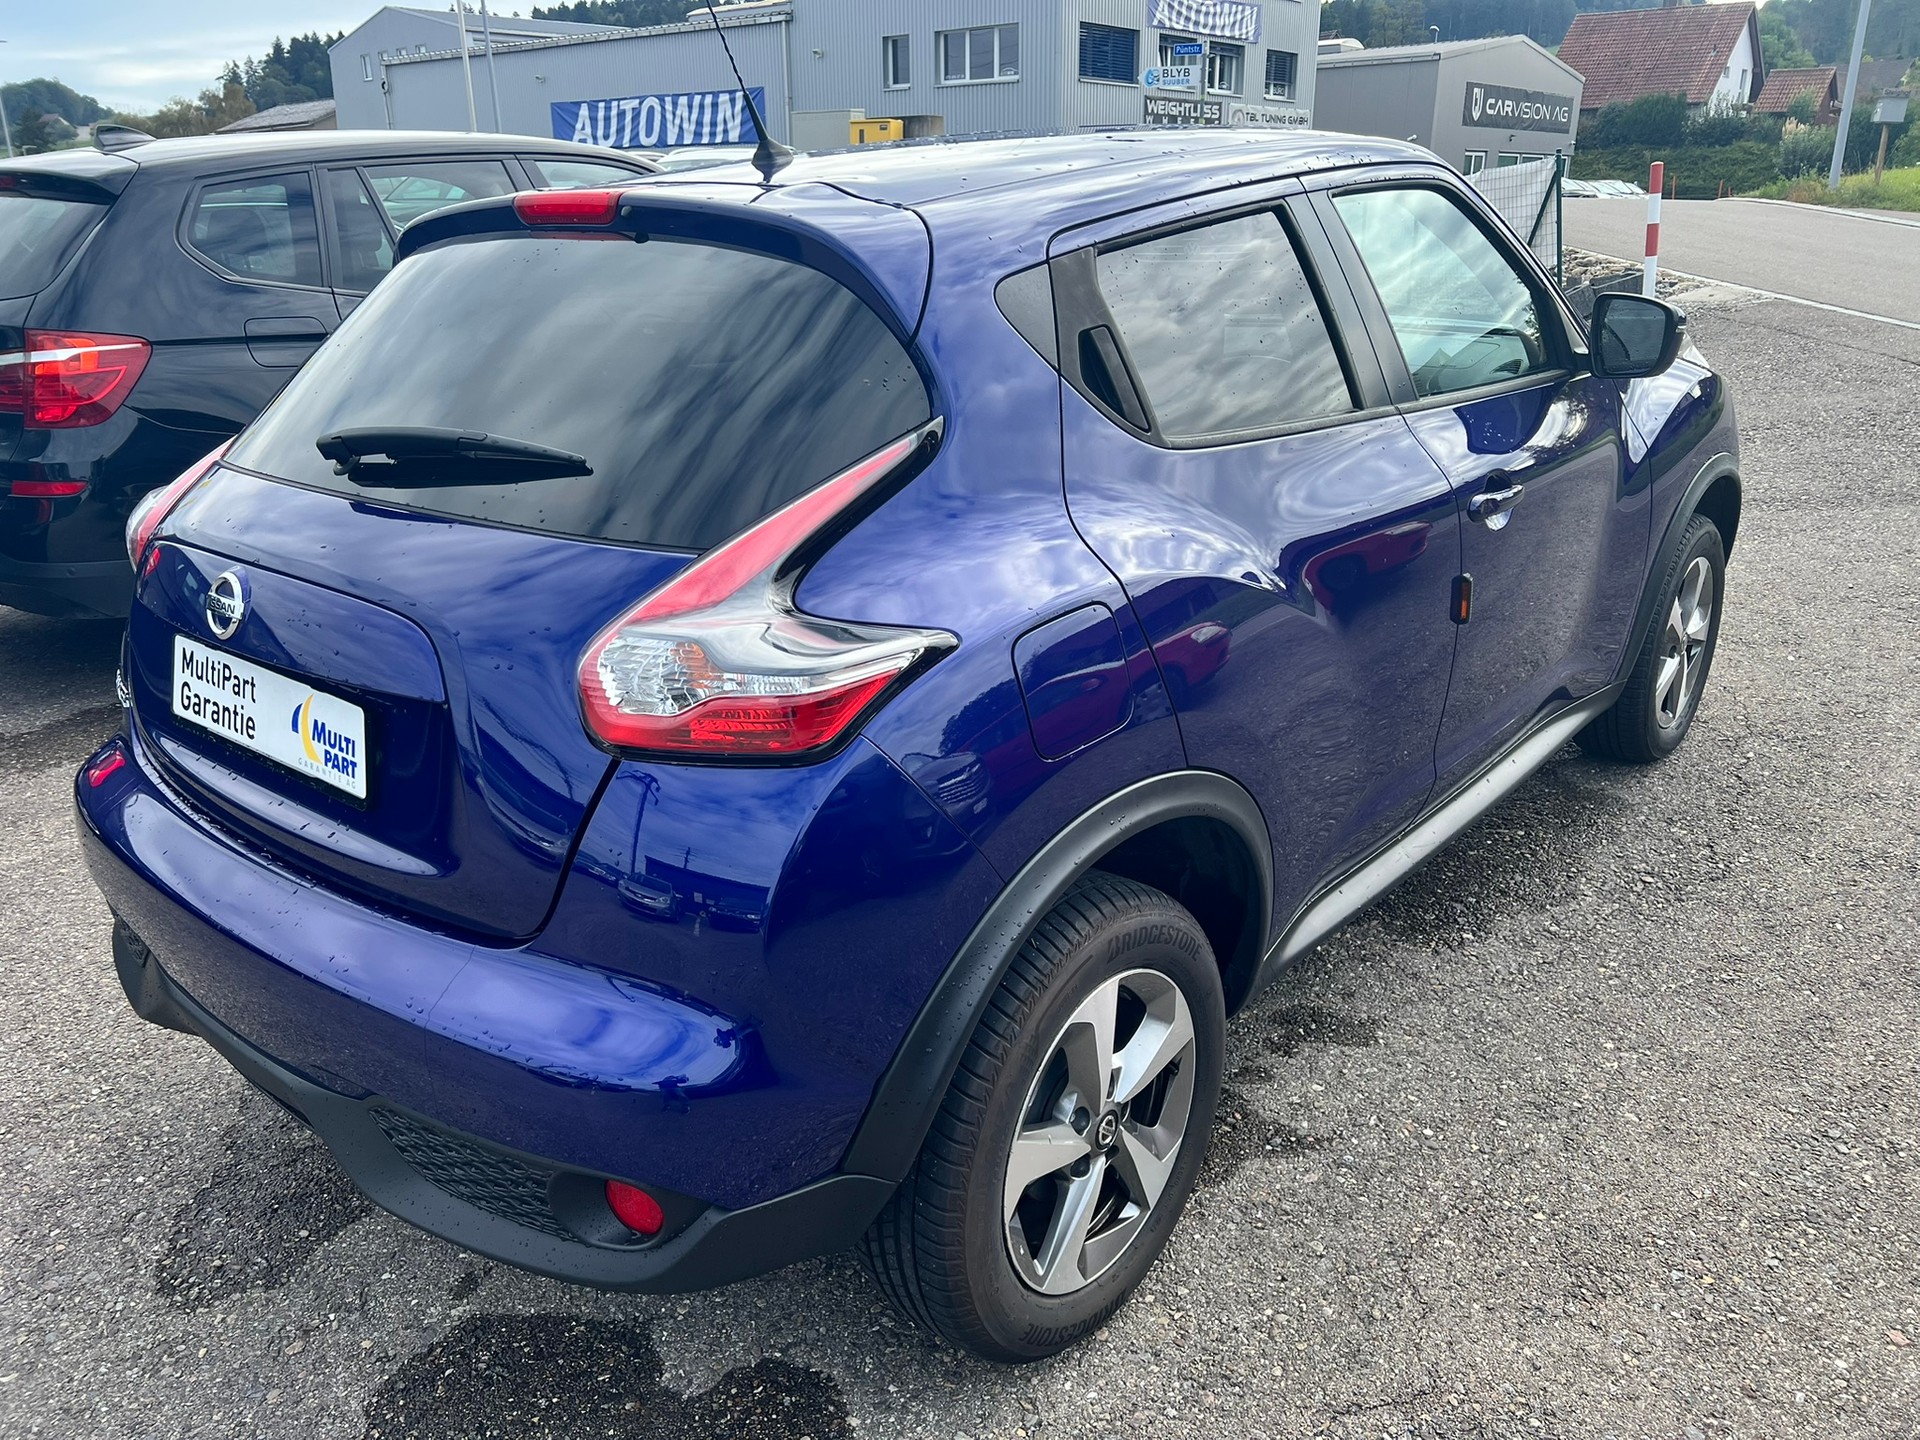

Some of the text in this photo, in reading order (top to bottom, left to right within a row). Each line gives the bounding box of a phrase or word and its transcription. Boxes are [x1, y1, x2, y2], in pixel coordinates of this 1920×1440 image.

[1162, 68, 1191, 78] BLYB
[572, 91, 745, 148] AUTOWIN
[1261, 113, 1287, 125] TUNING
[1486, 98, 1569, 122] CARVISION AG
[181, 646, 257, 704] MultiPart
[180, 681, 257, 740] Garantie
[312, 718, 356, 758] MULTI
[298, 757, 342, 783] GARANTIE
[324, 748, 358, 779] PART
[1106, 924, 1203, 964] BRIDGESTONE
